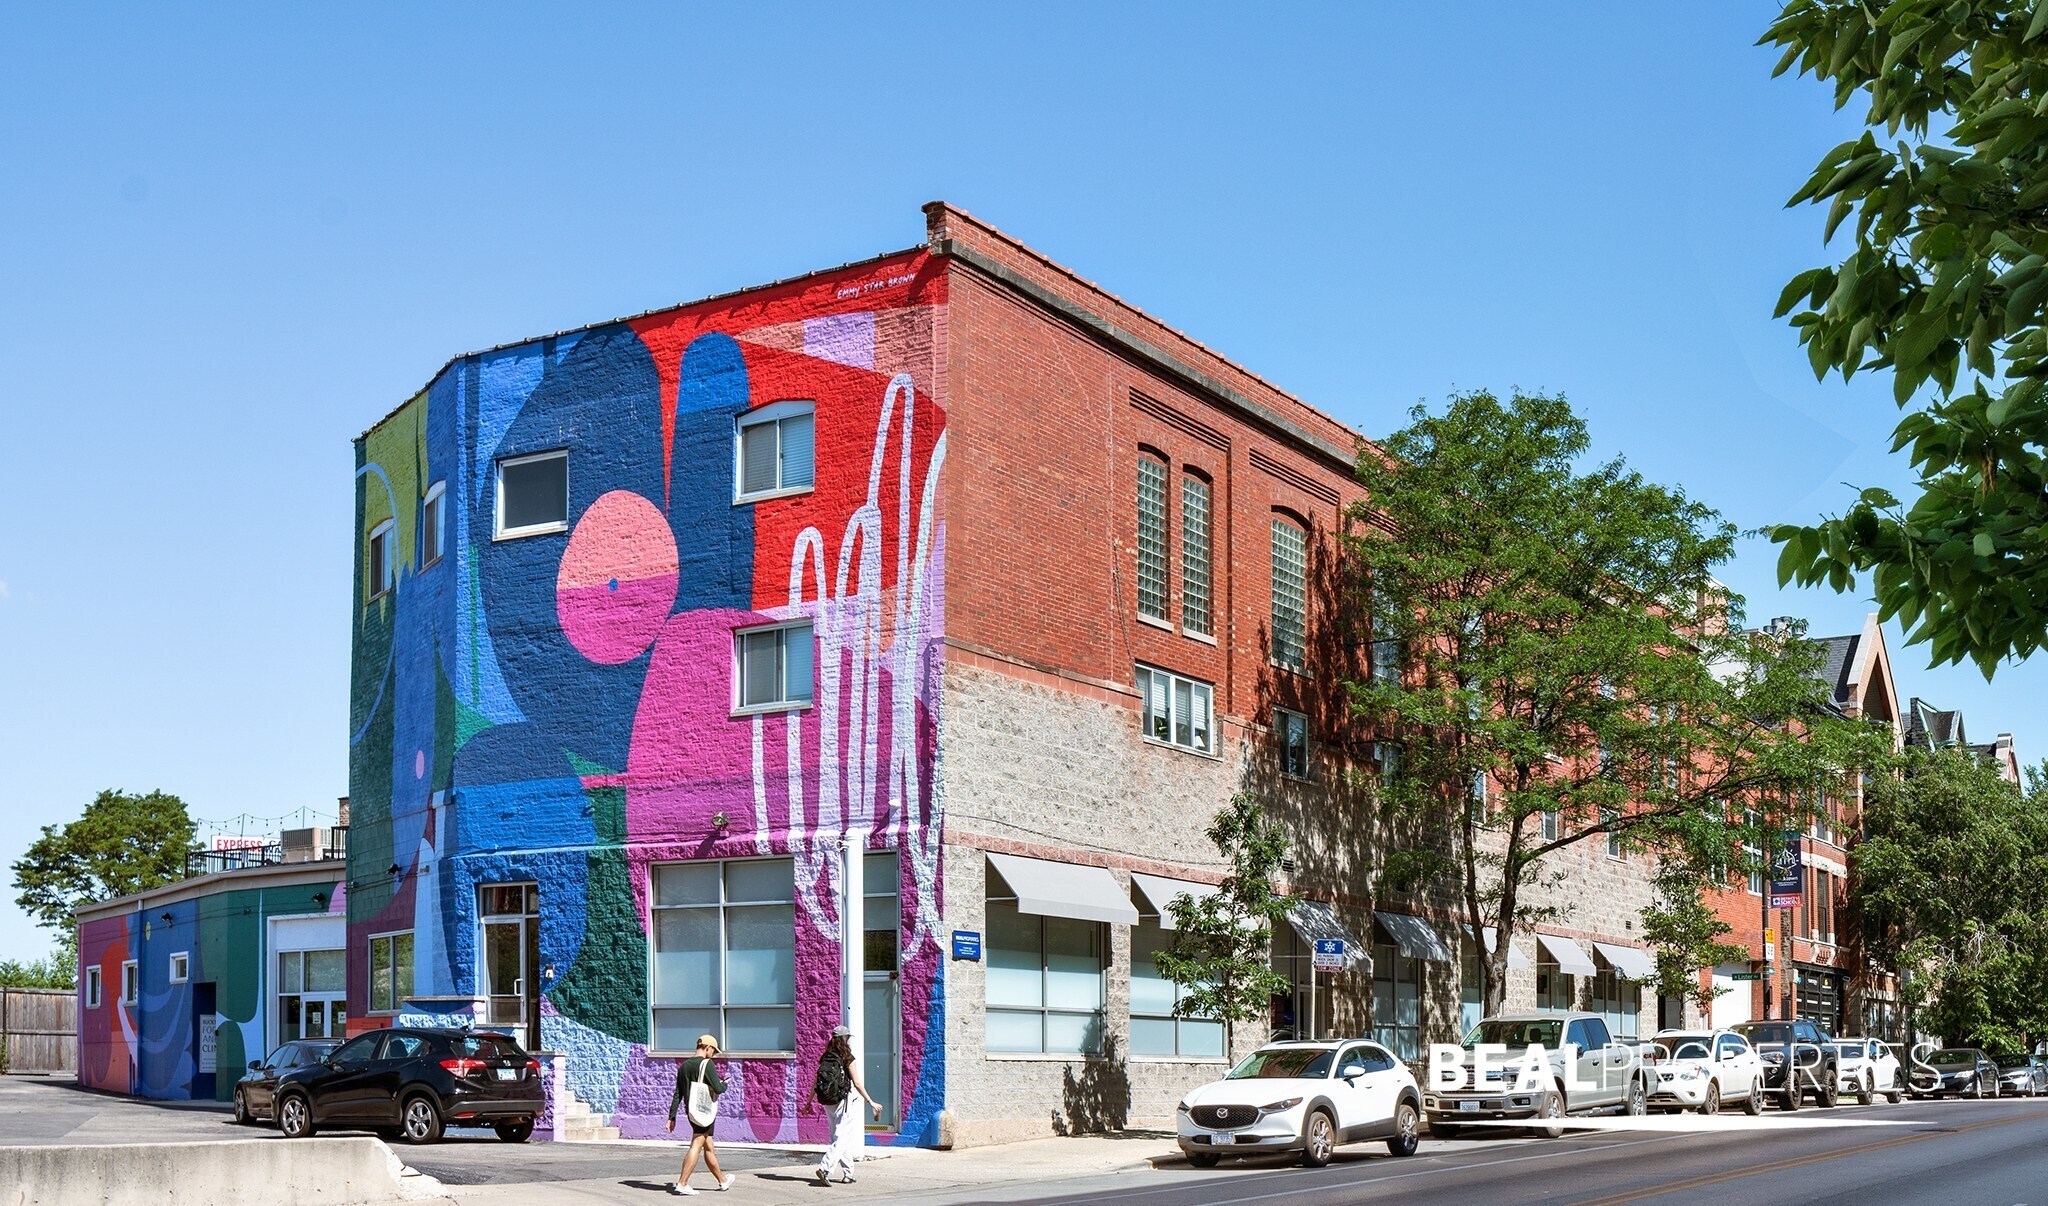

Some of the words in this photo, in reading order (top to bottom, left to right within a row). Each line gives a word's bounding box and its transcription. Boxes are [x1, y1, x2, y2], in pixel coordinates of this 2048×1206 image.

[837, 286, 860, 299] EMMY
[864, 281, 884, 292] STAR
[888, 273, 915, 287] BROWN
[216, 839, 263, 852] EXPRESS
